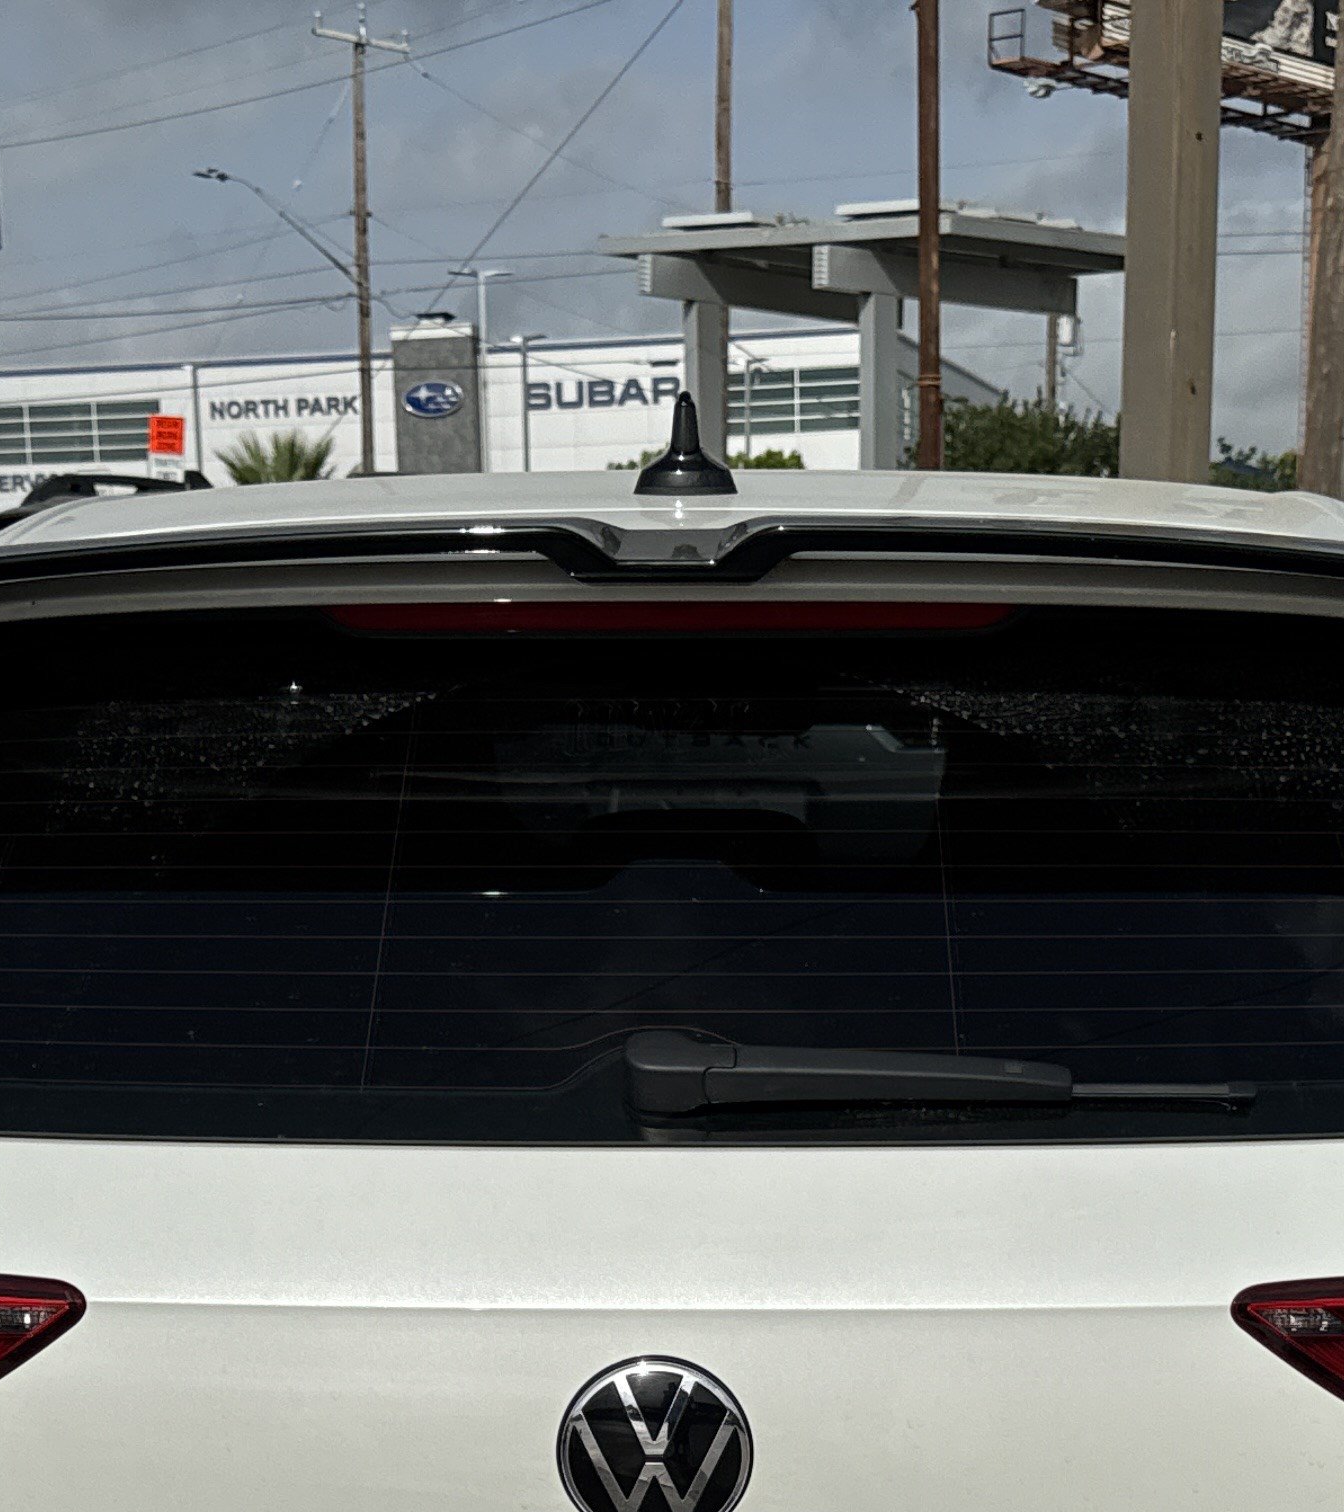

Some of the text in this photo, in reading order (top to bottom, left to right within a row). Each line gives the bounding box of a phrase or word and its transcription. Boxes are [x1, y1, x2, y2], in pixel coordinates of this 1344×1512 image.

[209, 395, 360, 421] NORTH PARK
[526, 376, 680, 411] SUBAR
